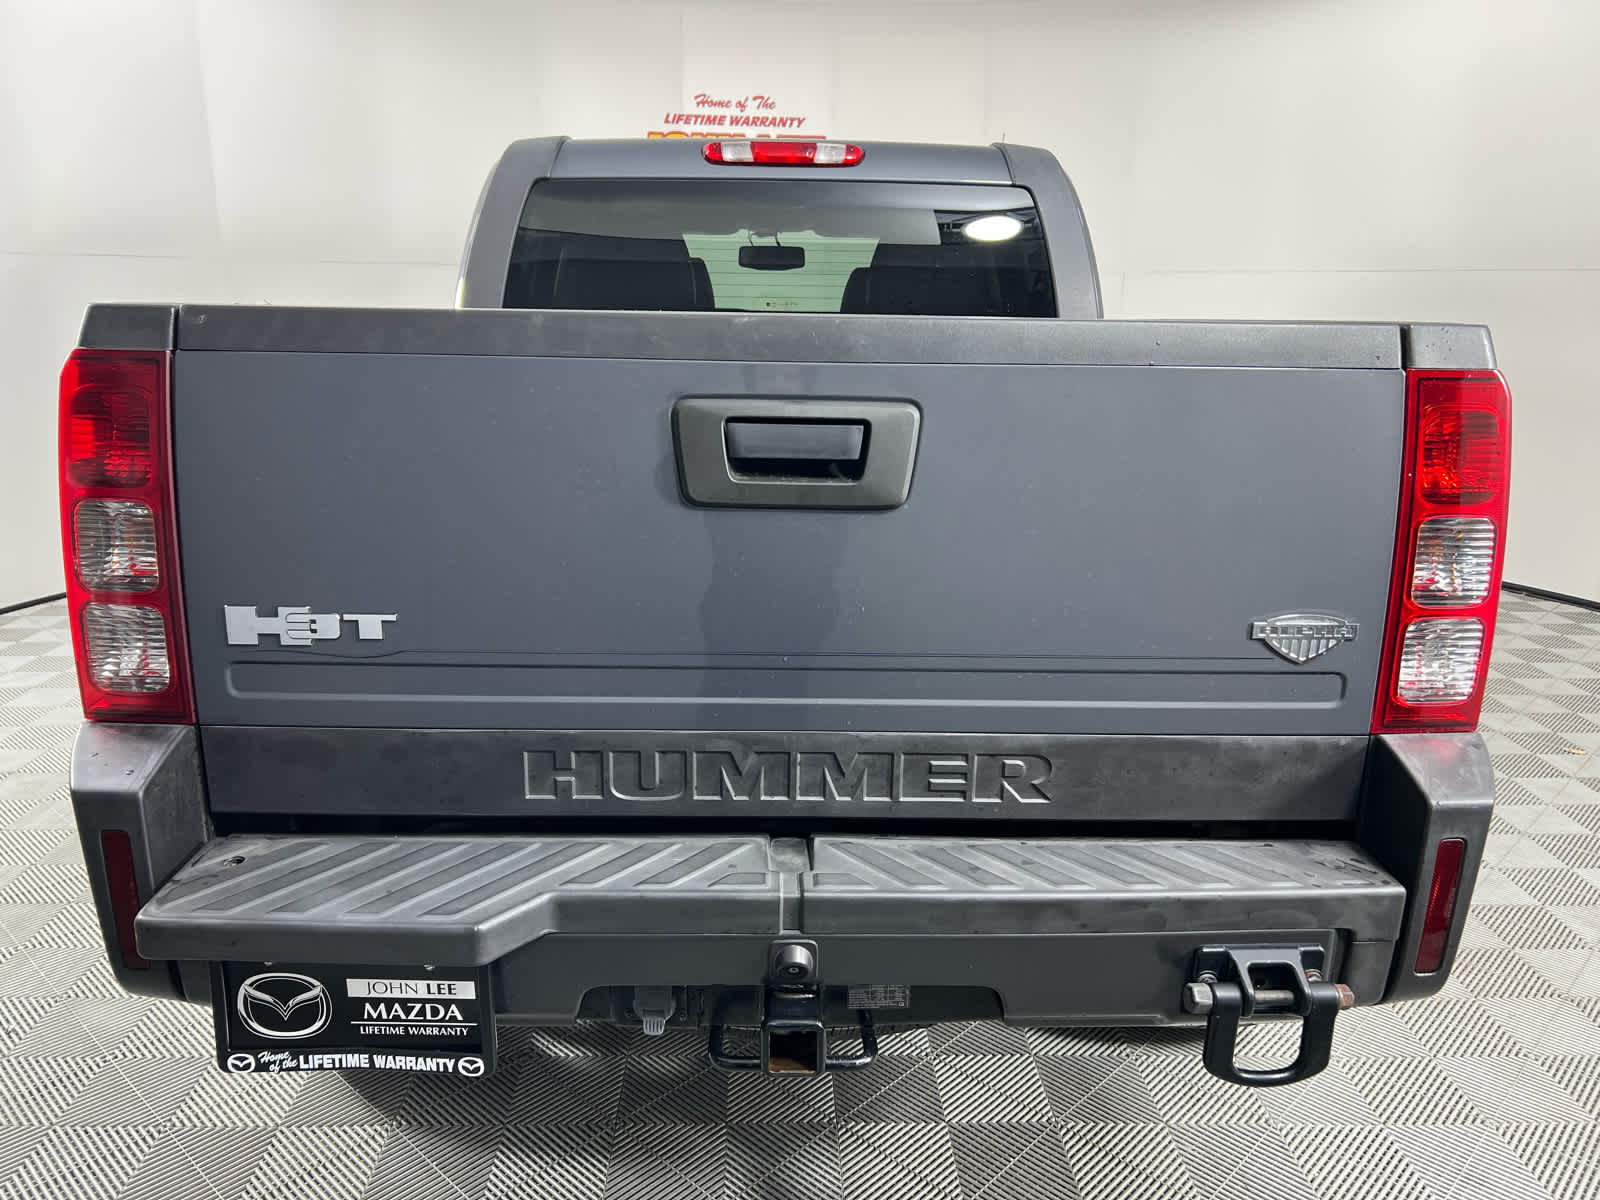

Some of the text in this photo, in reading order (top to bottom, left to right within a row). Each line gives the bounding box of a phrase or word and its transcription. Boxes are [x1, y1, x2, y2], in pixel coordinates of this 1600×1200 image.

[694, 93, 777, 112] Home of The
[664, 113, 805, 128] LIFETIME WARRANTY
[522, 750, 1053, 804] HUMMER
[367, 981, 457, 996] JOHN LEE
[363, 1003, 464, 1021] MAZDA
[360, 1025, 469, 1037] LIFETIME WARRANTY
[258, 1050, 290, 1065] Home
[269, 1056, 299, 1073] of the
[299, 1054, 456, 1073] LIFETIME WARRANTY
